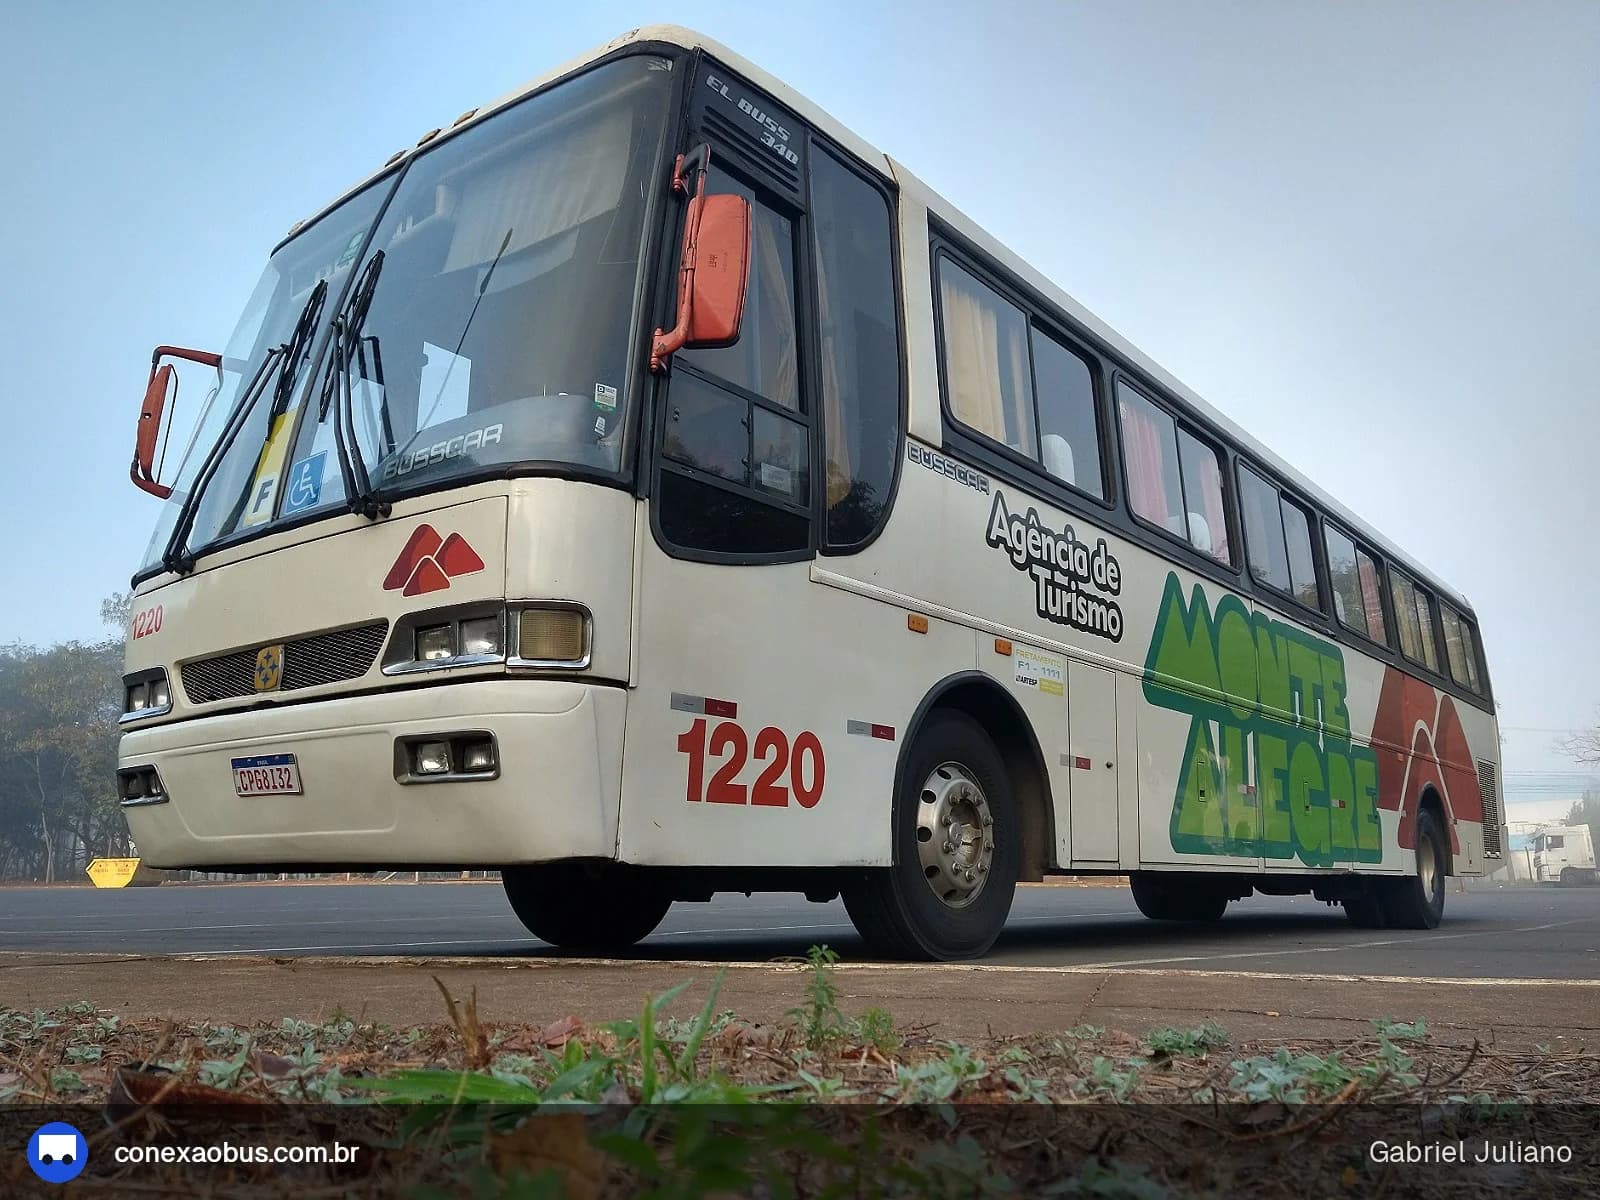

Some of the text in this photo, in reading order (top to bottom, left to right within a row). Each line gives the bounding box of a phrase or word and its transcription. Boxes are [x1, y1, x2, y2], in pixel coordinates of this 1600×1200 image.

[706, 75, 791, 141] EL BUSS
[760, 131, 799, 165] 340
[383, 423, 504, 480] BUSSCAR
[907, 441, 990, 496] BUSSCAR
[252, 479, 274, 514] F
[988, 494, 1120, 593] Agência de
[132, 604, 163, 641] 1220
[1031, 563, 1122, 640] Turismo
[1146, 580, 1348, 737] MONTE
[677, 718, 826, 809] 1220
[1173, 717, 1381, 862] ALEGRE
